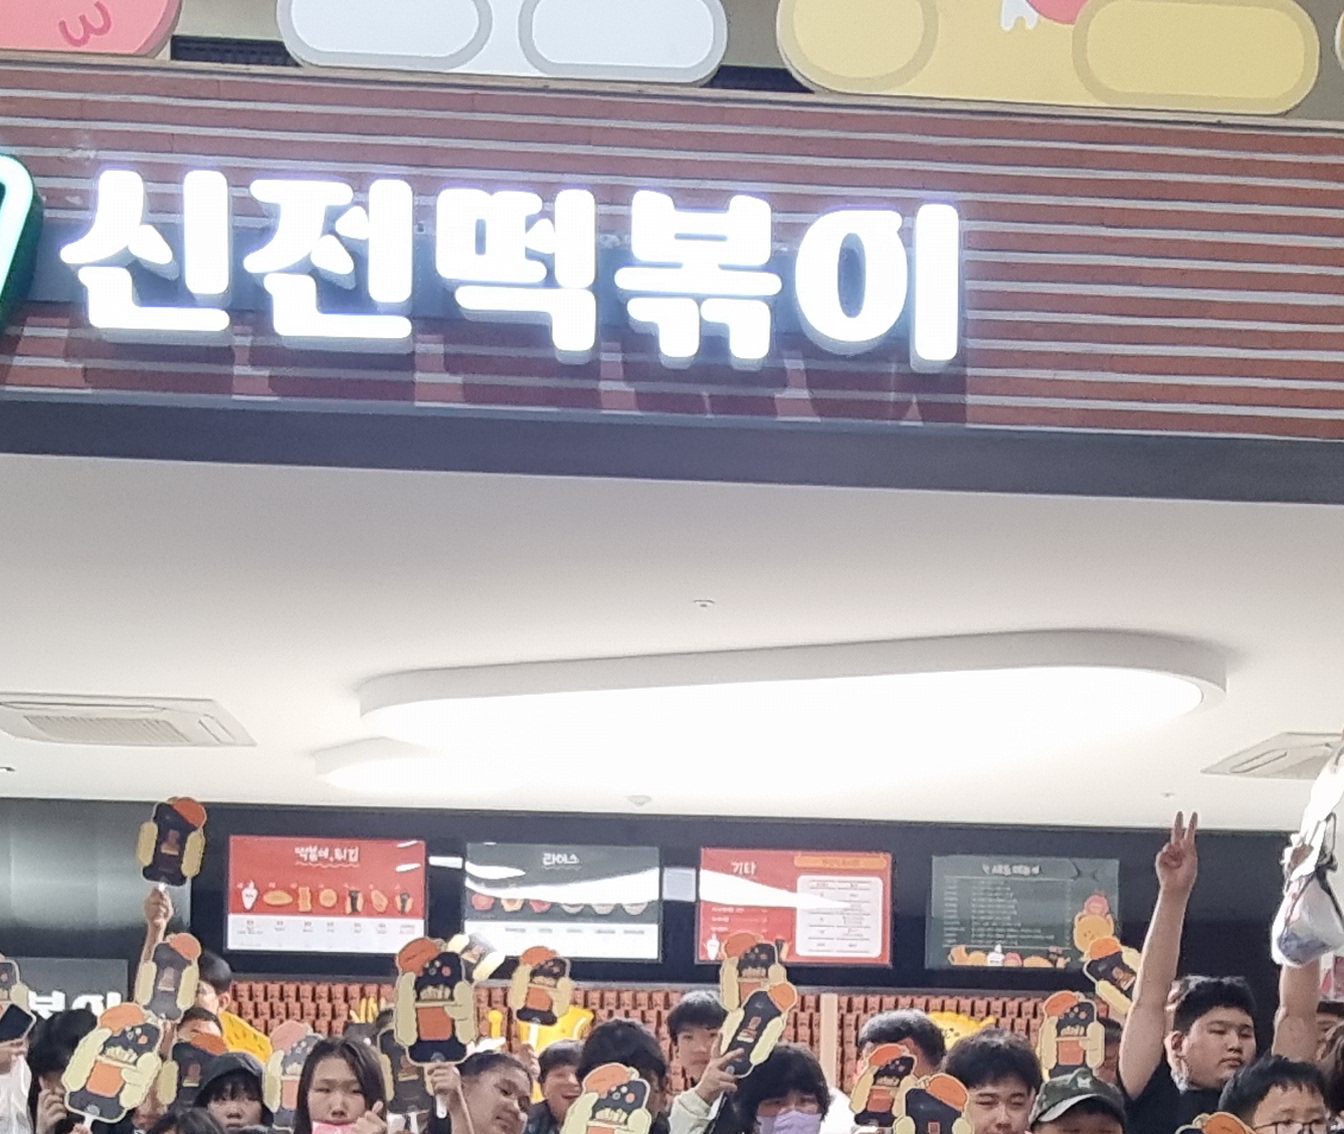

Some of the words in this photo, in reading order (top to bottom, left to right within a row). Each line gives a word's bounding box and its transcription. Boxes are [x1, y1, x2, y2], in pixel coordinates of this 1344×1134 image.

[60, 168, 960, 368] 신전떡볶이
[542, 853, 580, 866] 라이스
[731, 860, 757, 875] 기타
